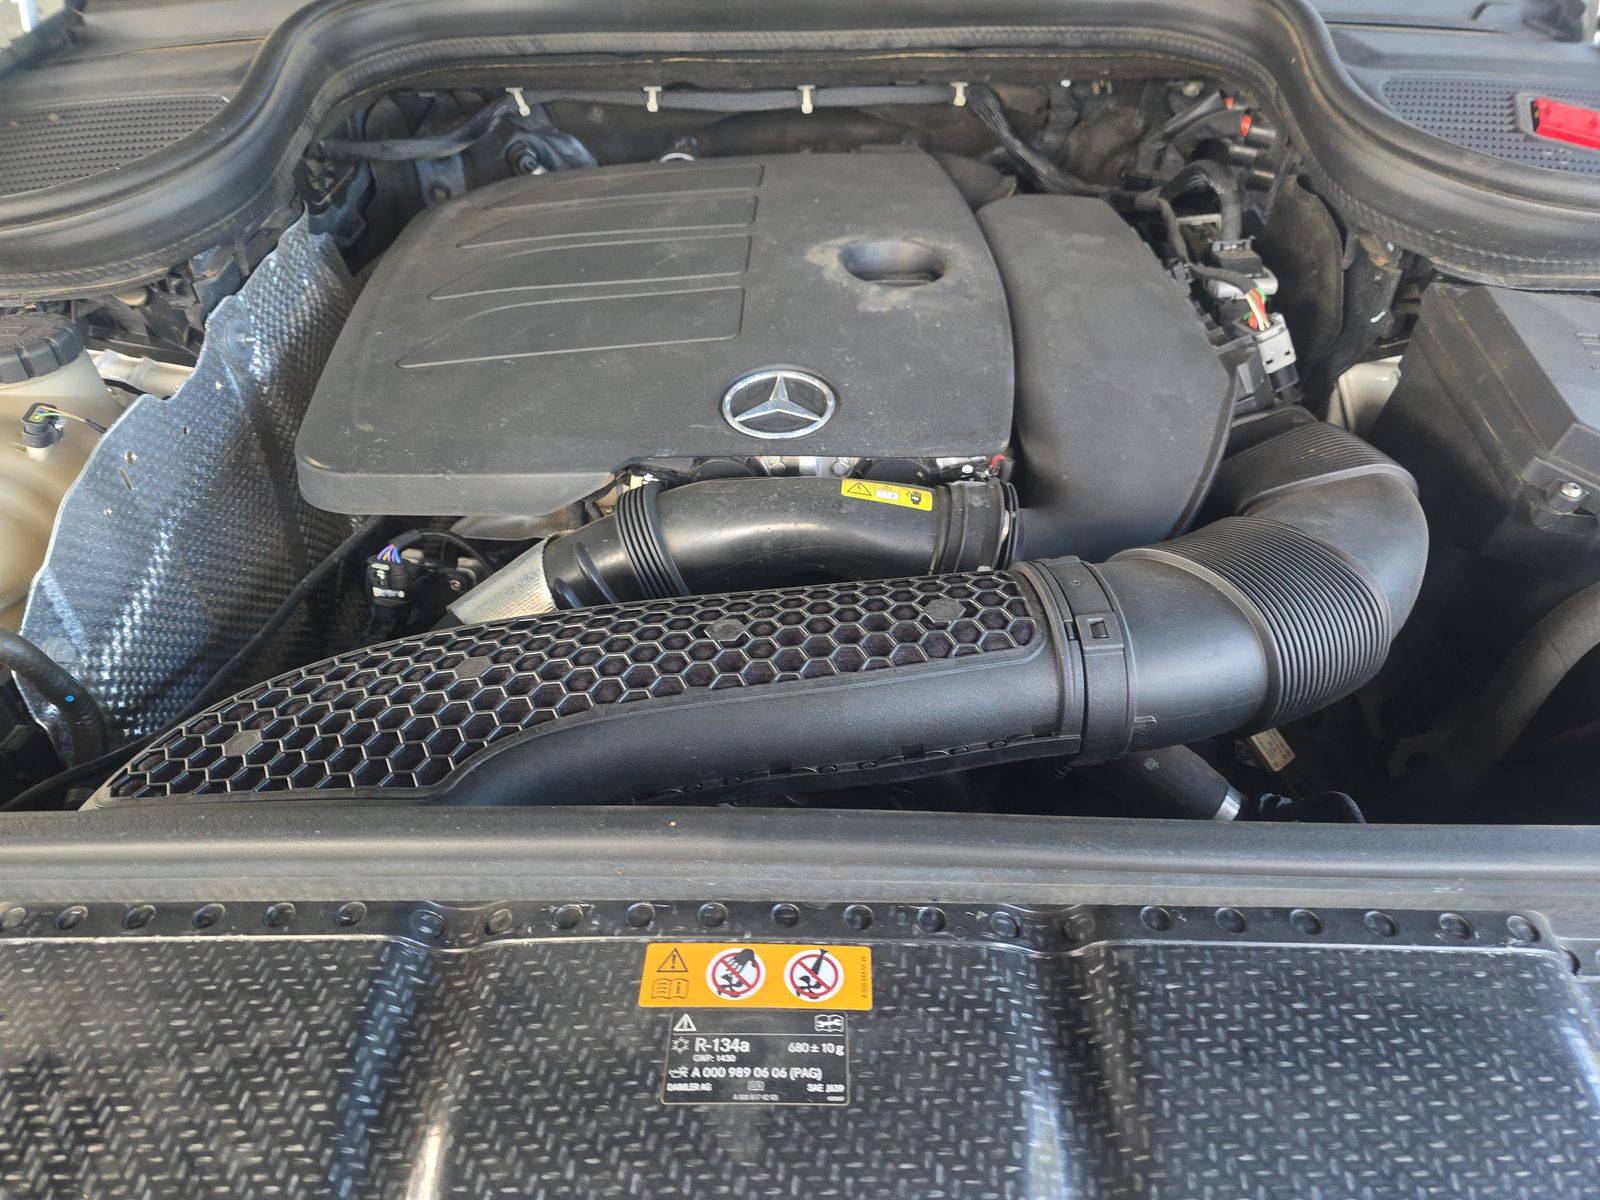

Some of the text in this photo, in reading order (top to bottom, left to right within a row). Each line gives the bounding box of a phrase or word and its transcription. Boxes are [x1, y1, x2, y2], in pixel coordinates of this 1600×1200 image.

[694, 1037, 750, 1053] R-134a
[690, 1066, 823, 1081] A 000 989 06 06 (PAG)
